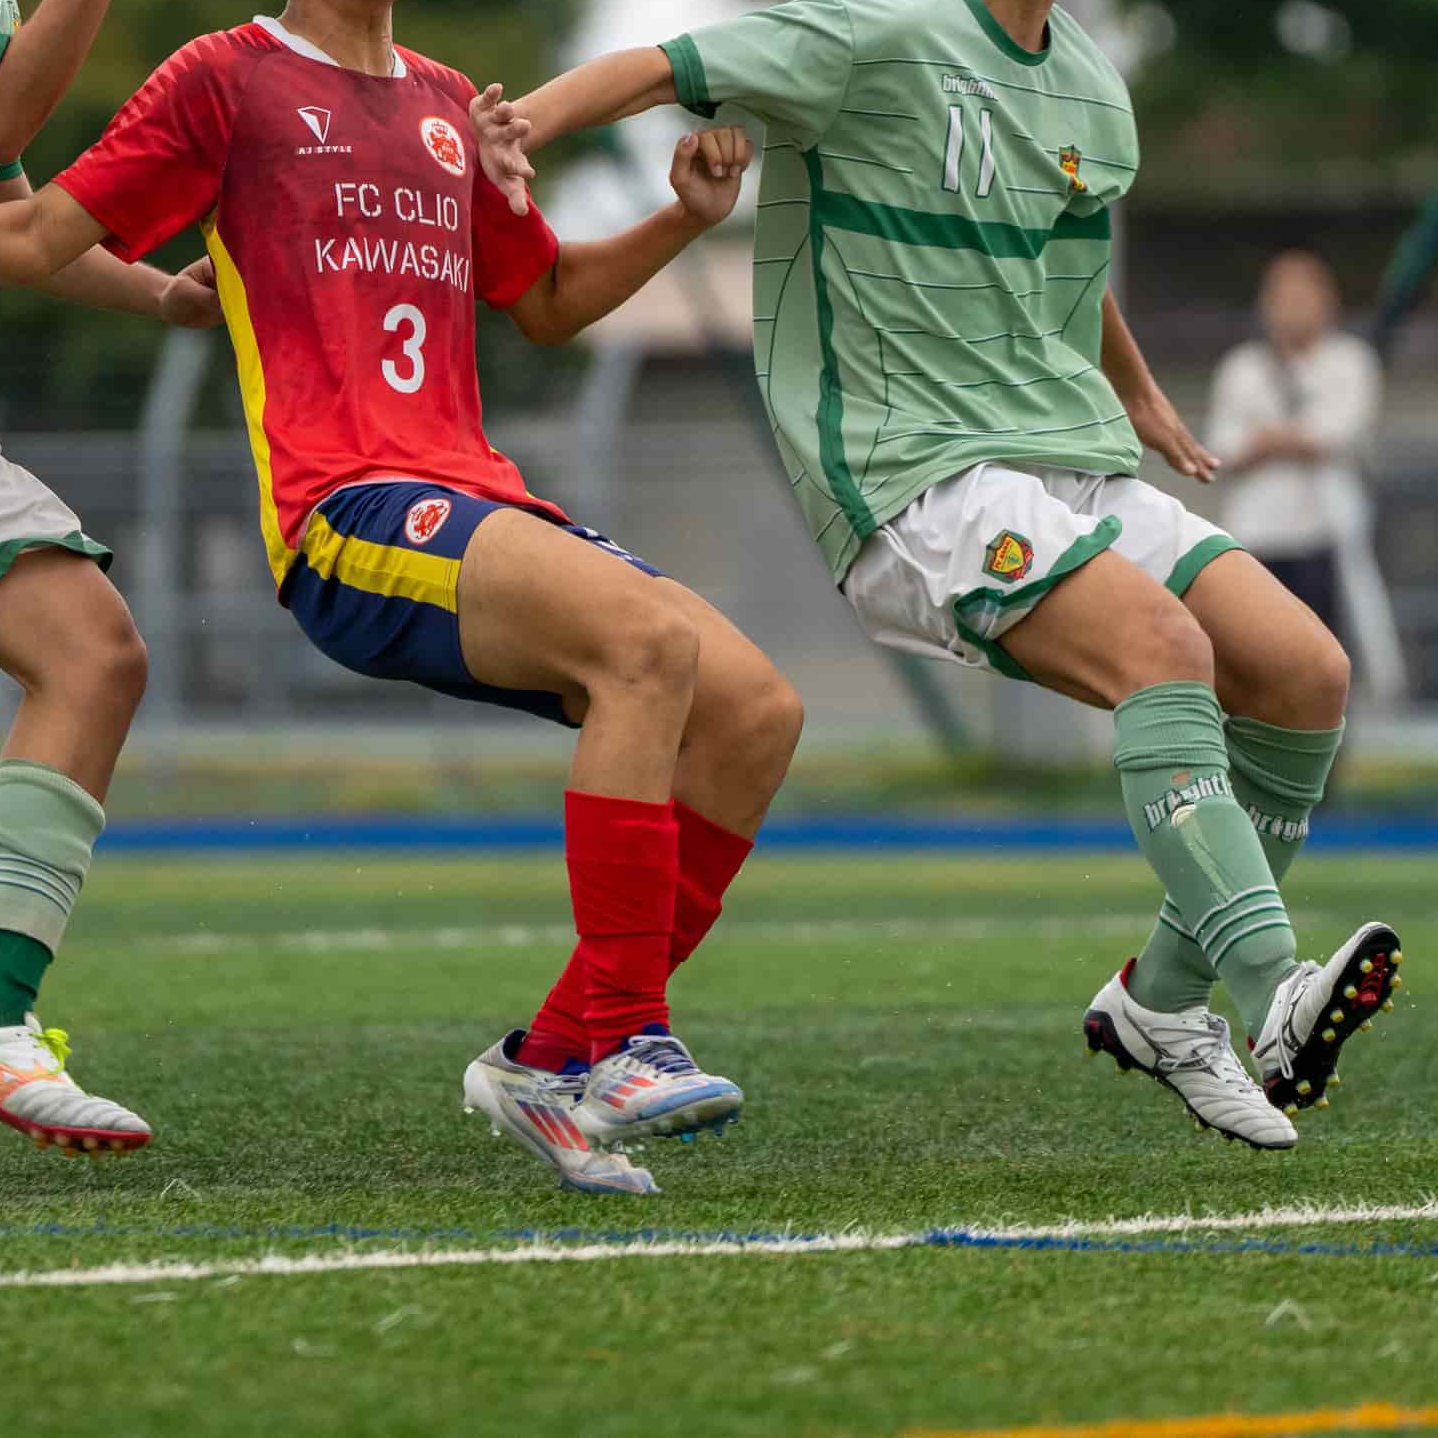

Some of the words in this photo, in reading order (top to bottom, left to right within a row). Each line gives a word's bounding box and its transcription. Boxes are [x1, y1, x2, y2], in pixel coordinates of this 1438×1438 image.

[941, 103, 996, 199] 11
[335, 182, 382, 217] FC
[394, 186, 458, 231] CLIO
[314, 237, 469, 293] KAWASAKI
[381, 303, 426, 393] 3
